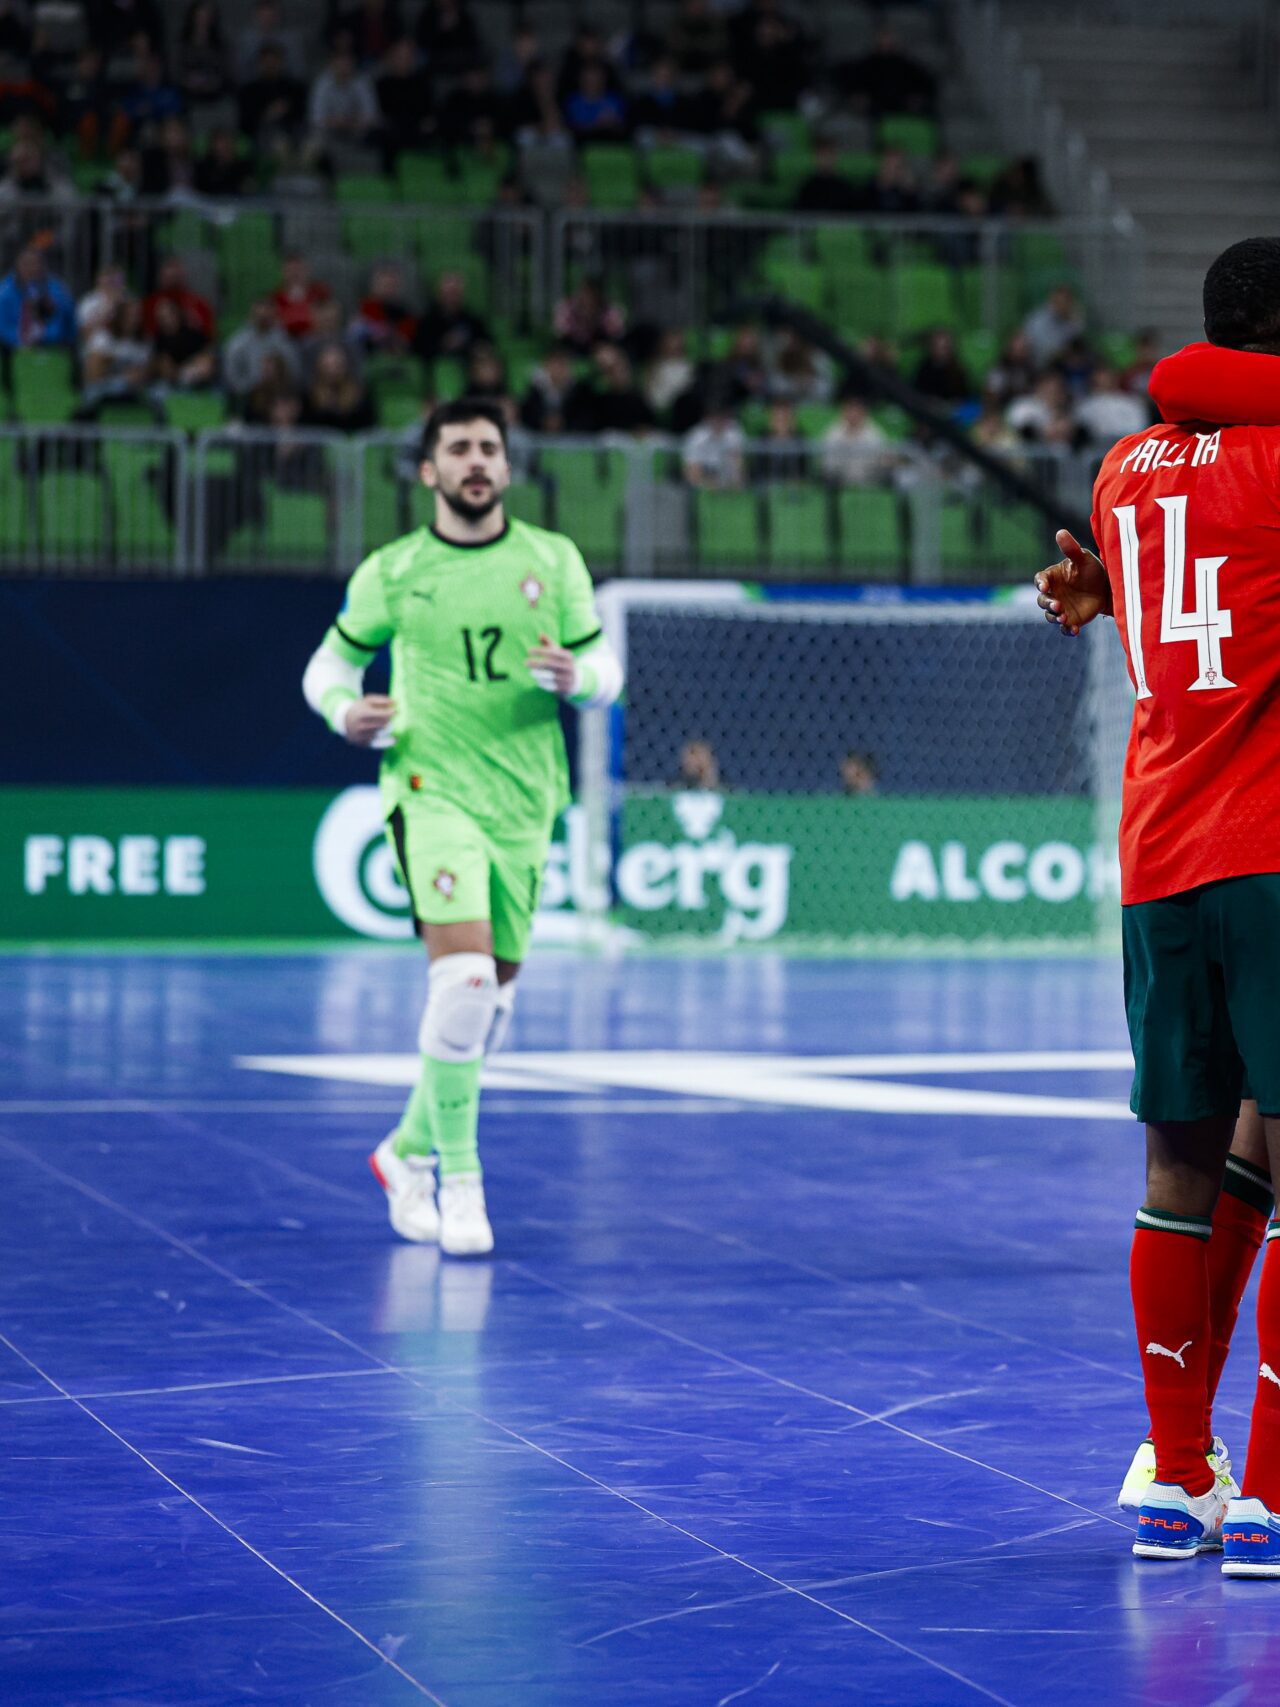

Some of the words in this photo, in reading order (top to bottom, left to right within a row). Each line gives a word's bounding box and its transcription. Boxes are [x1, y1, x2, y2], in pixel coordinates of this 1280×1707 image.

[1111, 495, 1238, 700] 14
[461, 627, 509, 681] 12
[24, 834, 206, 896] FREE
